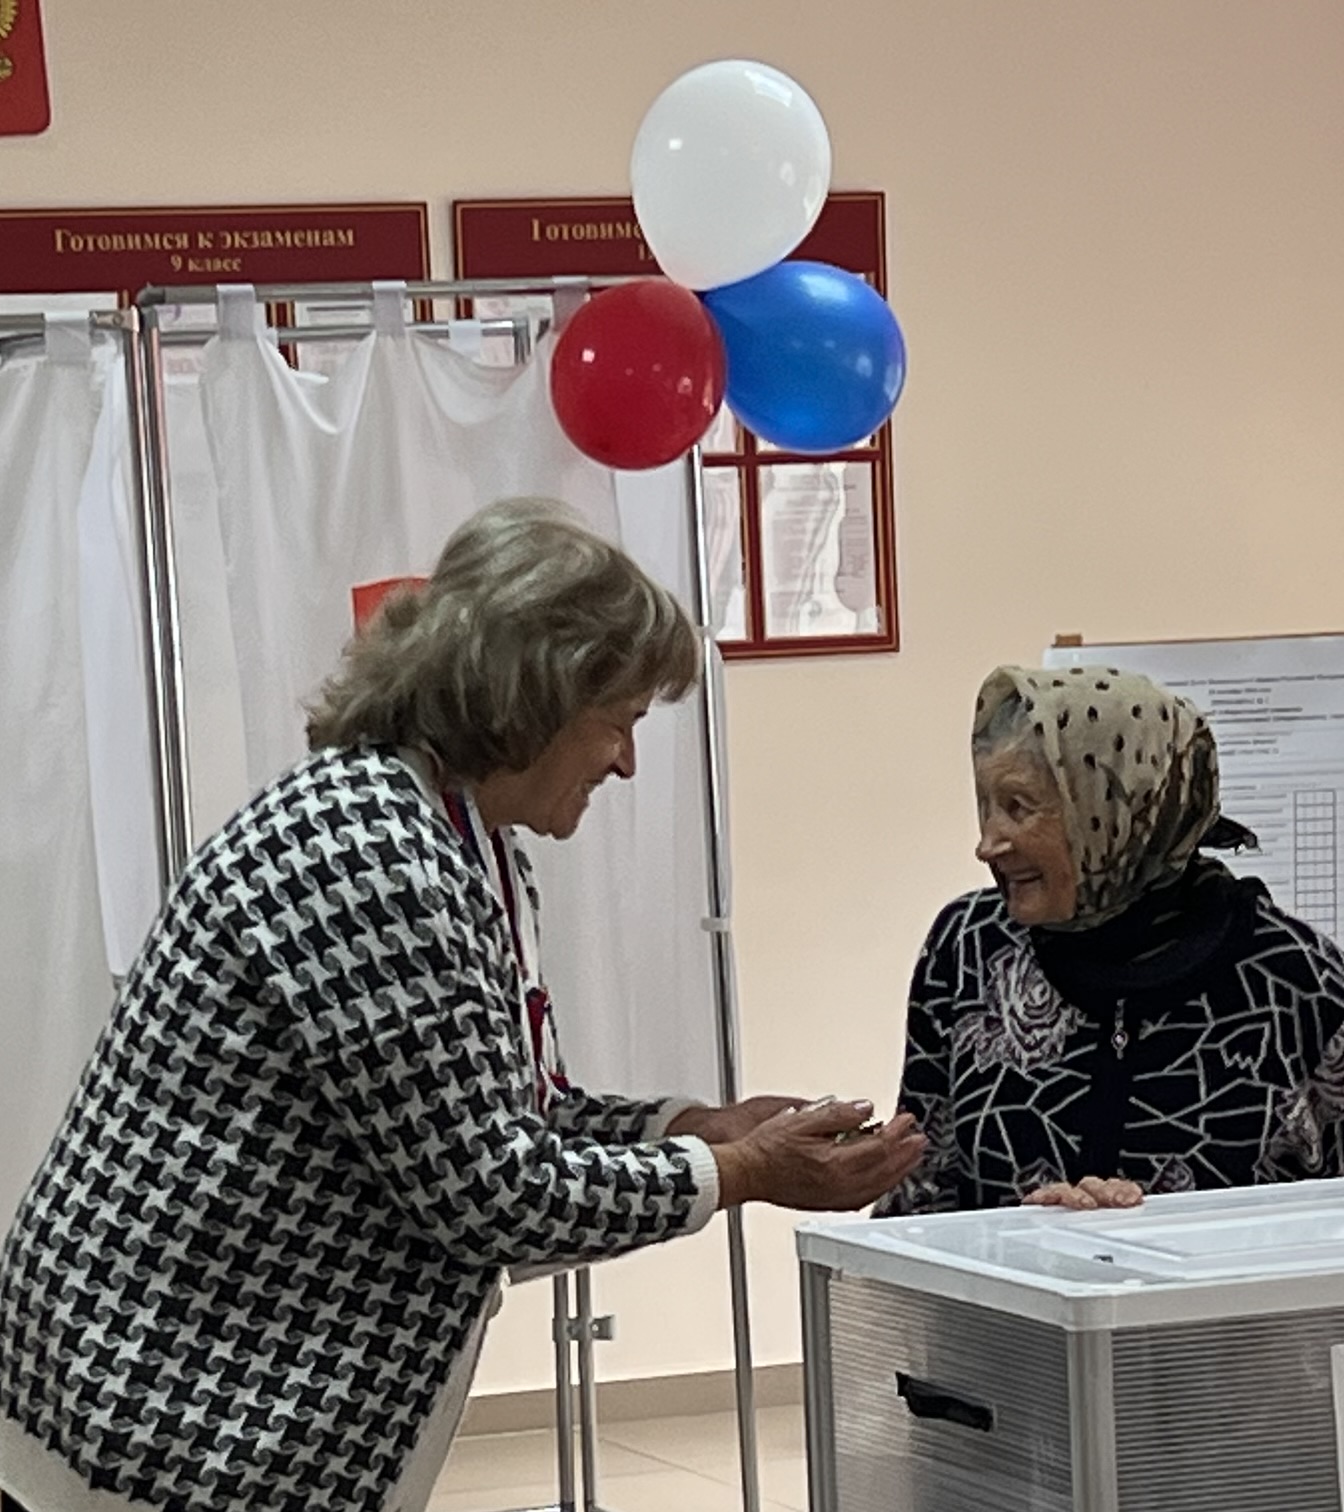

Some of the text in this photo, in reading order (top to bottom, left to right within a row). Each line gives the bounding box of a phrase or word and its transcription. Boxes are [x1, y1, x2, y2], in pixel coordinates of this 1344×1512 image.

[54, 228, 355, 252] Готовимся к экзаменам
[531, 217, 643, 241] Готовимс
[170, 255, 242, 273] 9 класс
